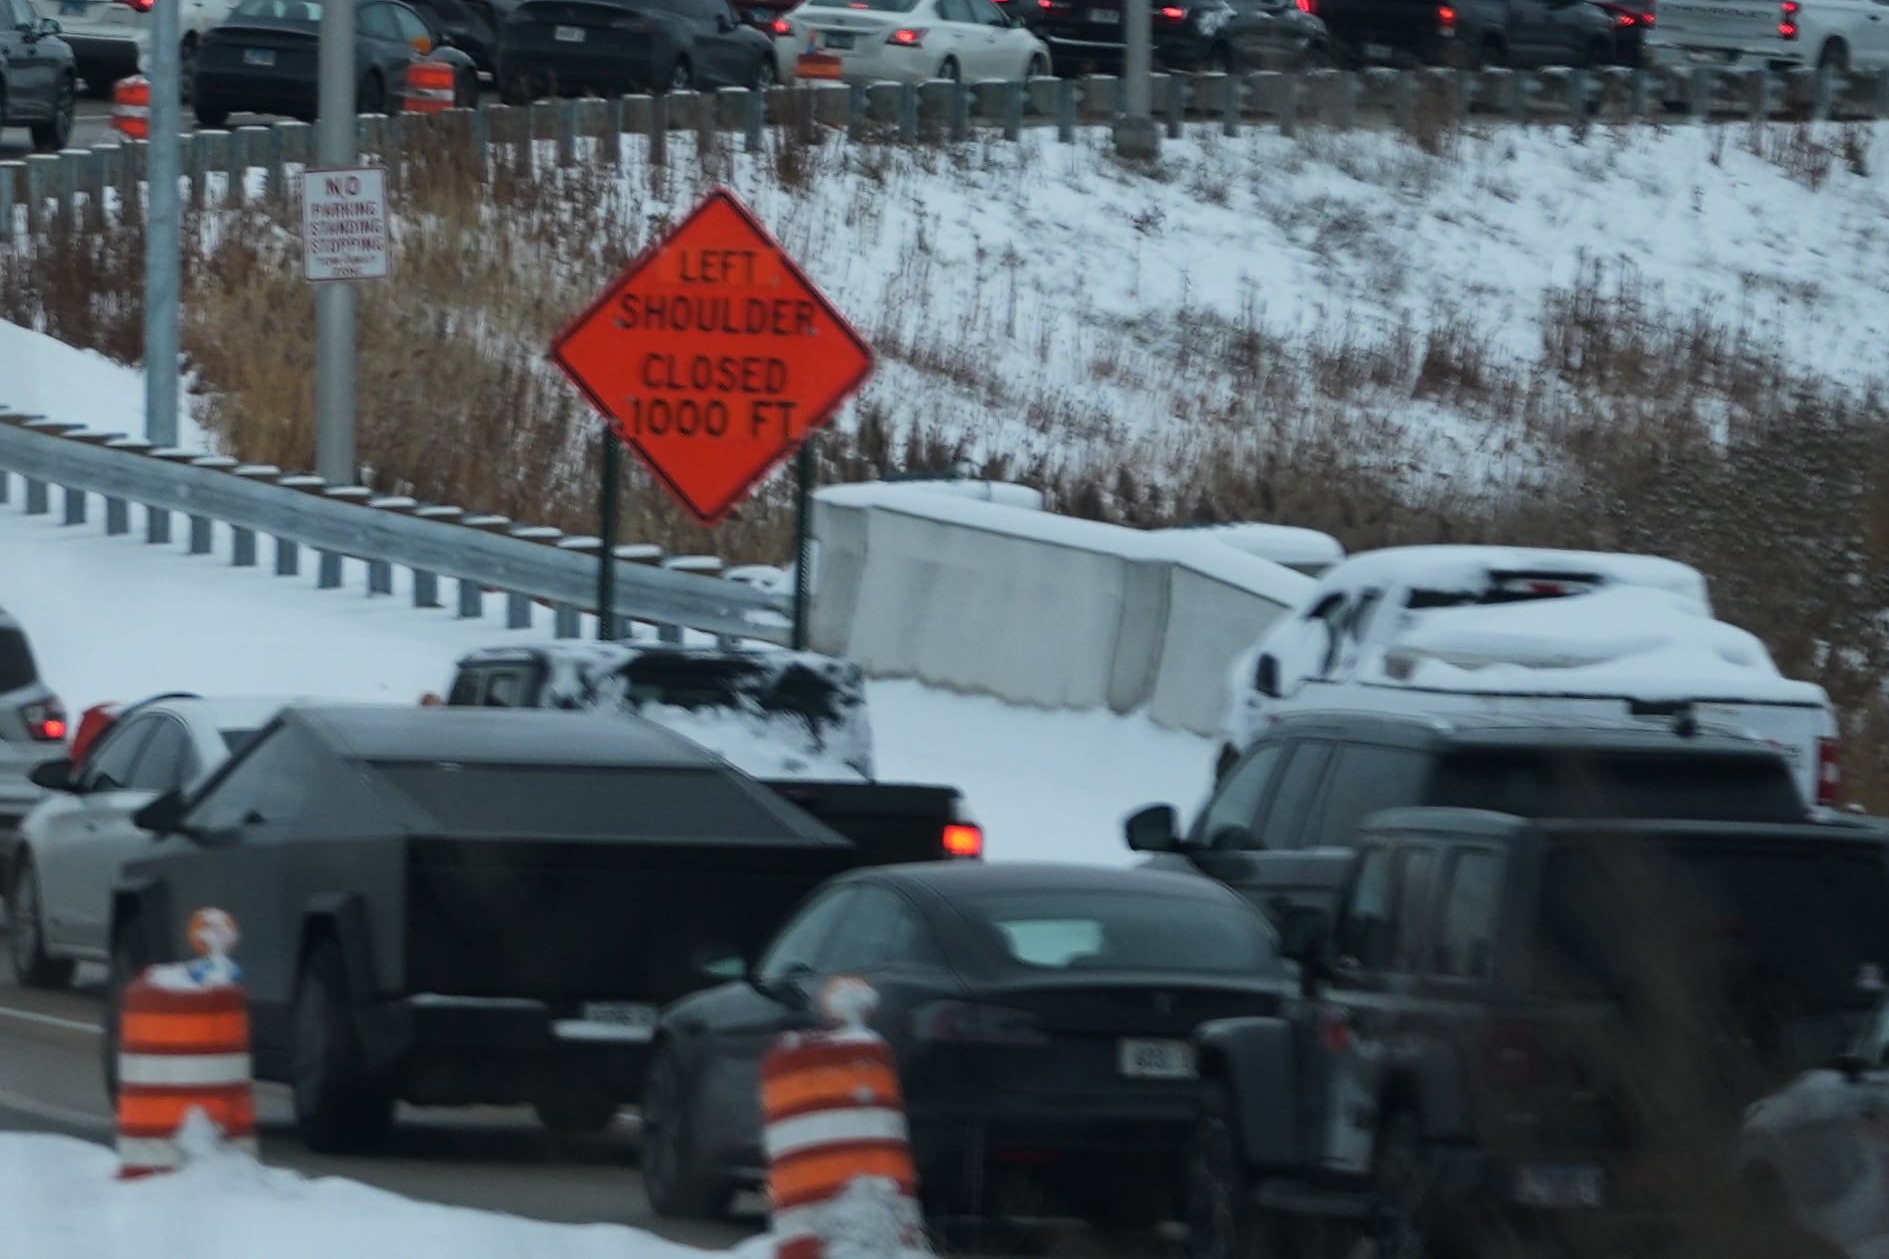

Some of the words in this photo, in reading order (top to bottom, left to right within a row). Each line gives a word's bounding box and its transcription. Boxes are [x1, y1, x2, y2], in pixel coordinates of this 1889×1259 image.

[325, 175, 362, 197] NO
[310, 218, 383, 237] STANDING
[312, 202, 377, 219] PARKING
[679, 249, 758, 283] LEFT
[618, 293, 816, 336] SHOULDER
[641, 352, 789, 394] CLOSED
[631, 399, 729, 438] 1000
[750, 399, 798, 439] FT
